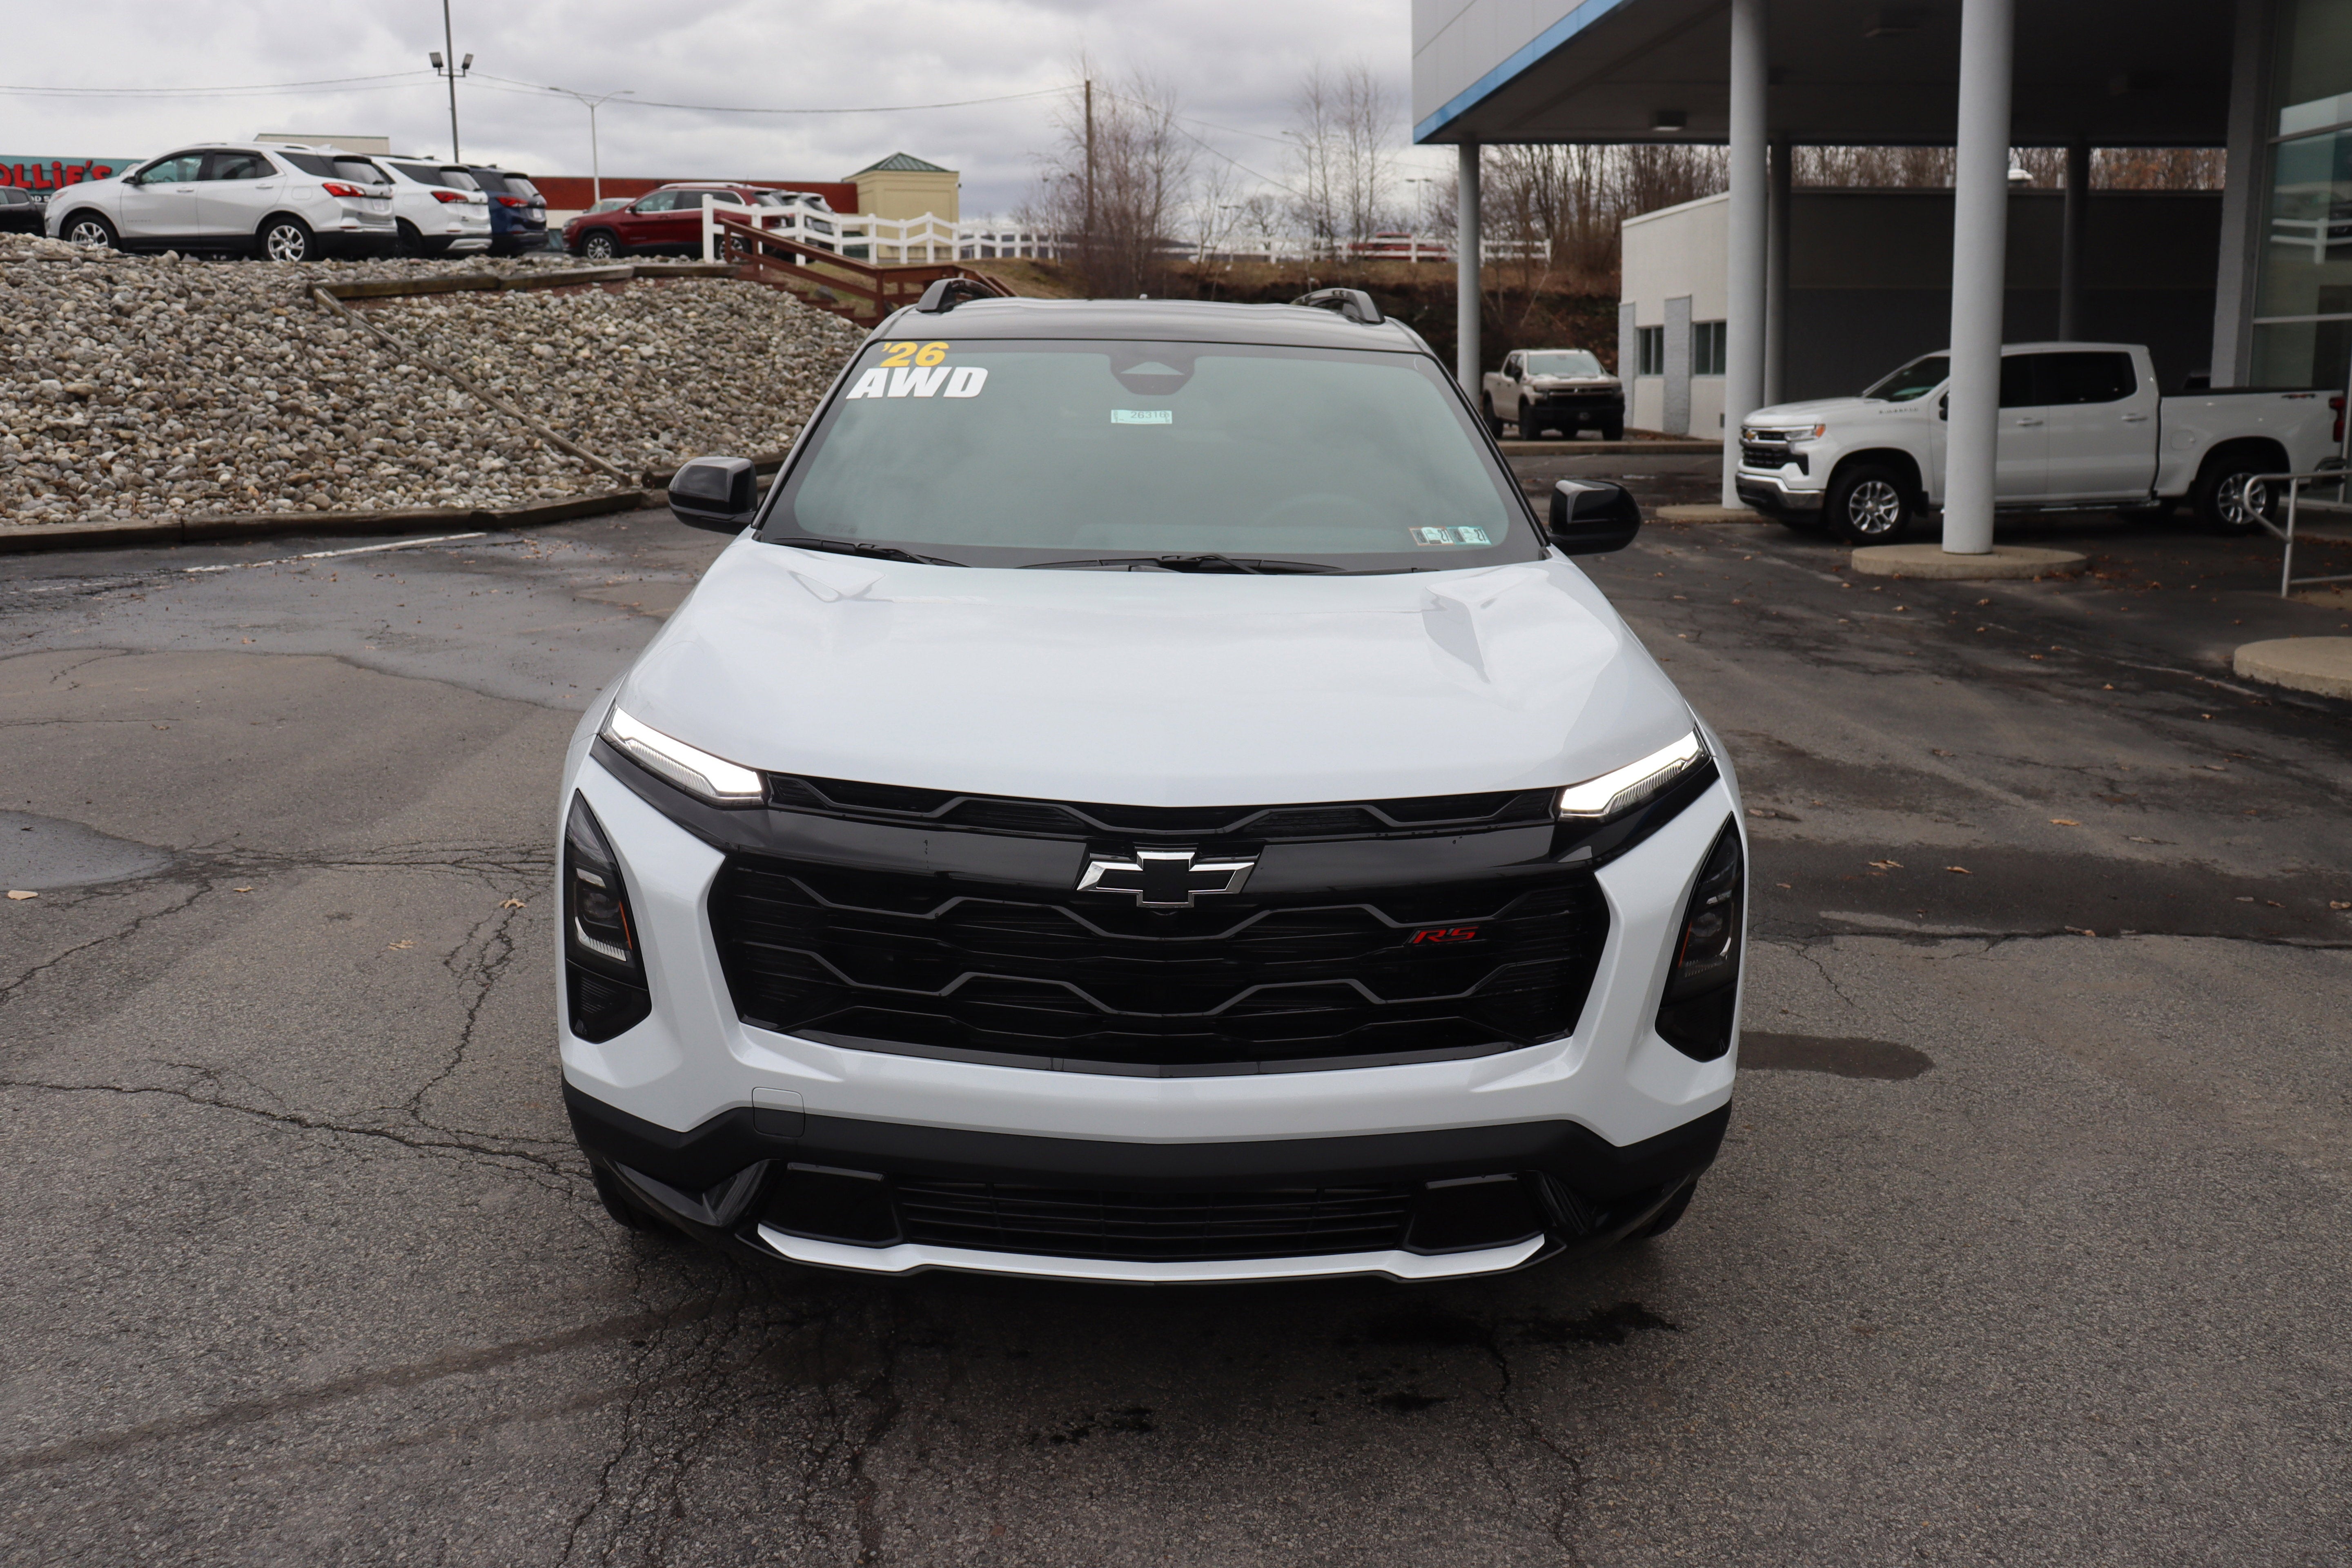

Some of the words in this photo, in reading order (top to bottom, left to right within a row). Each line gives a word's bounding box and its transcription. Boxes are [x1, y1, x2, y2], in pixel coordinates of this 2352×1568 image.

[880, 342, 949, 367] '26
[846, 367, 988, 399] AWD
[1412, 926, 1479, 943] RS
